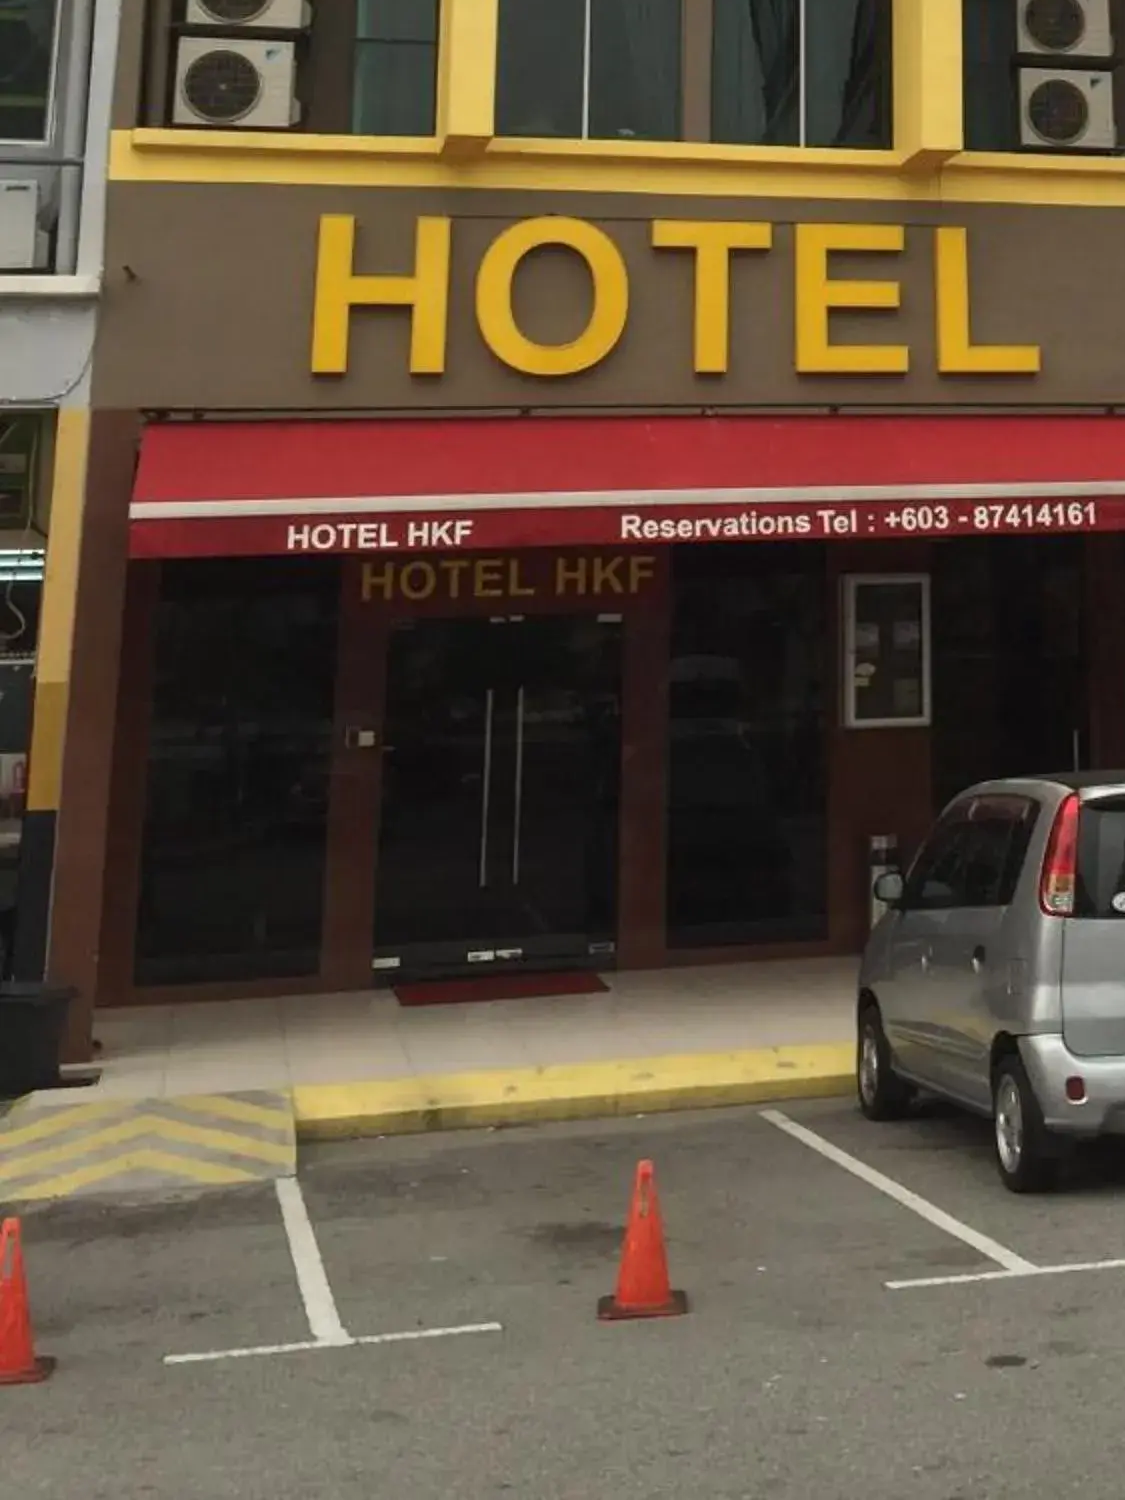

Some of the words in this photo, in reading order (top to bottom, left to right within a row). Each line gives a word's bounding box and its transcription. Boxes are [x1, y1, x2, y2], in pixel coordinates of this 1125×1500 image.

[310, 213, 1042, 375] HOTEL
[287, 522, 399, 549] HOTEL
[407, 520, 473, 547] HKF
[620, 509, 811, 539] Reservations
[817, 510, 858, 534] Tel
[885, 505, 950, 532] +603
[974, 502, 1096, 529] 87414161
[361, 559, 536, 601] HOTEL
[555, 555, 656, 596] HKF
